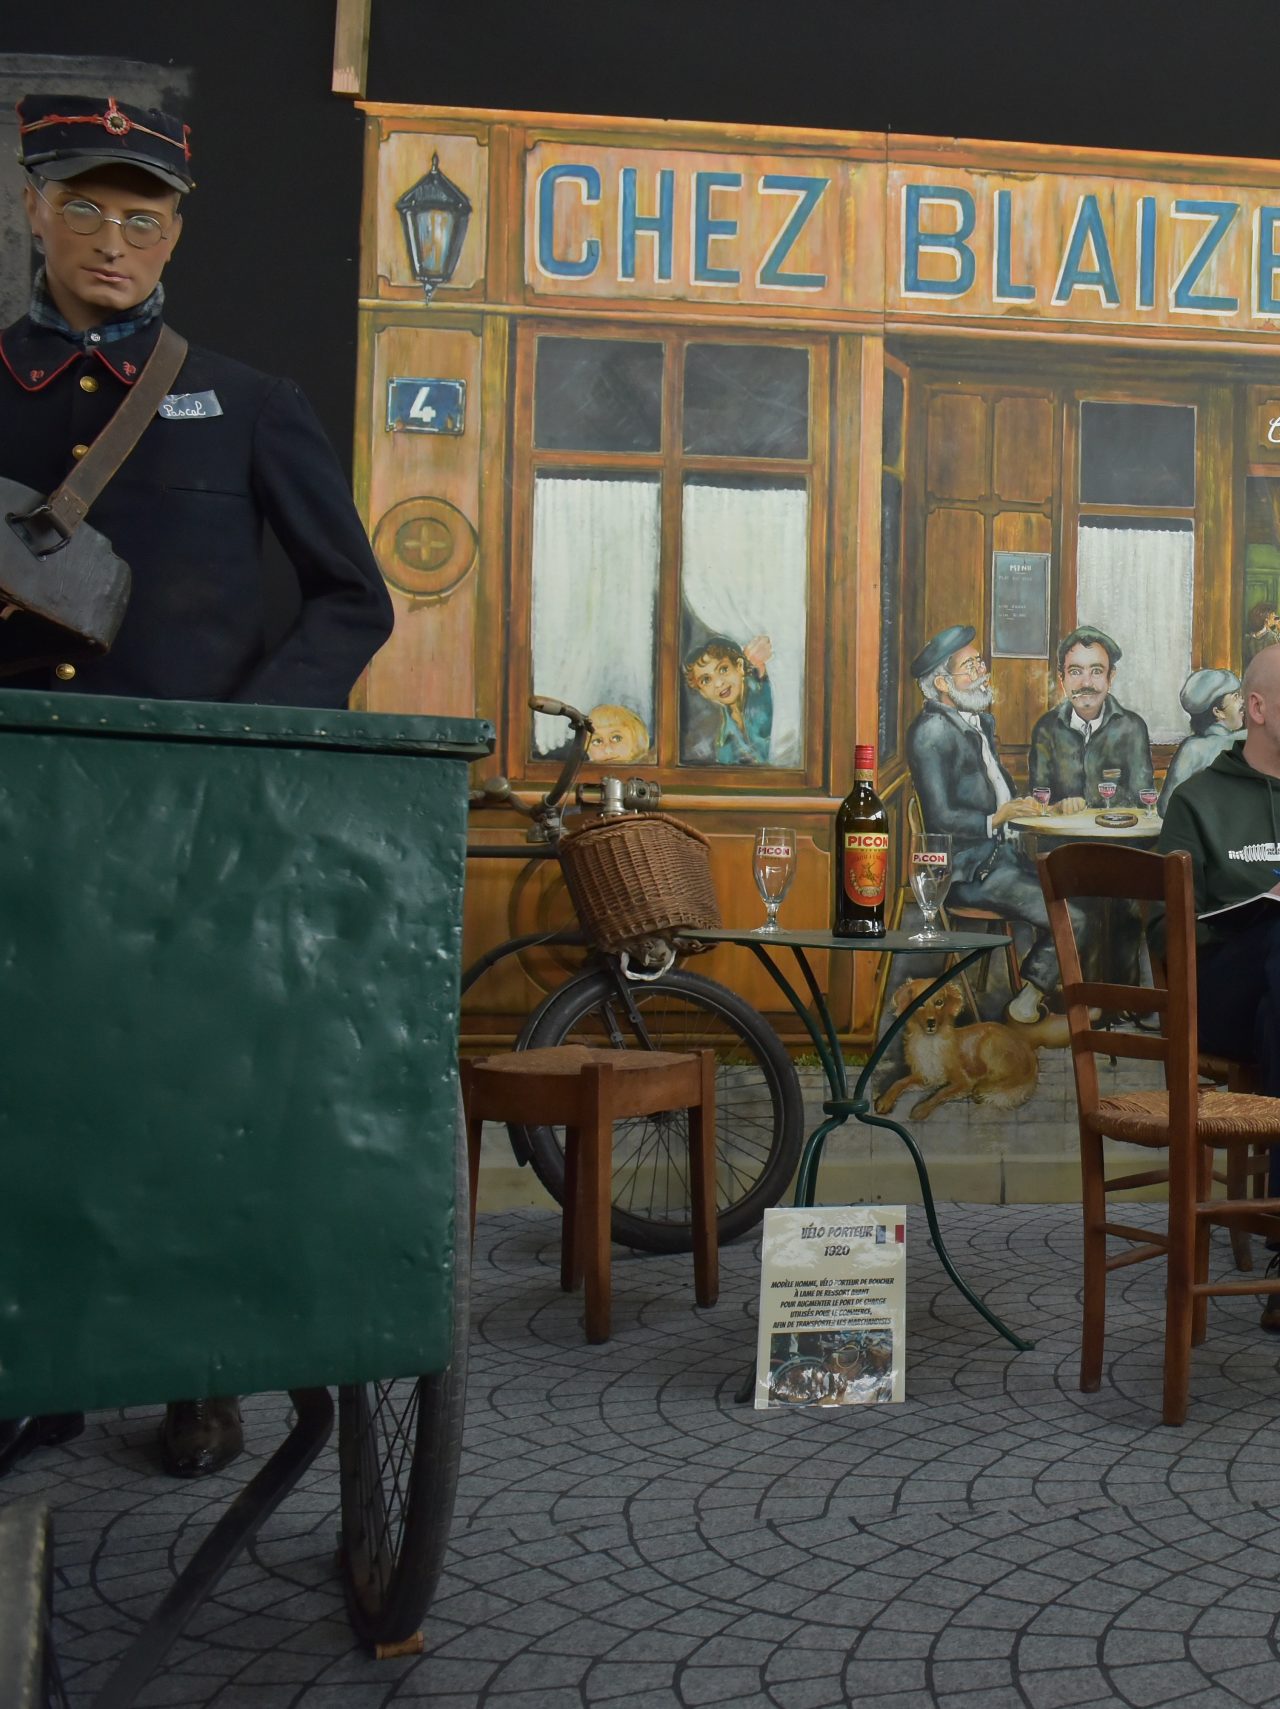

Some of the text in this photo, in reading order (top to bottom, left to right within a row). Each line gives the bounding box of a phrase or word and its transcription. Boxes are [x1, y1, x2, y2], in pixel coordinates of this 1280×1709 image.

[535, 163, 831, 292] CHEZ
[163, 400, 206, 417] Pascal
[409, 386, 436, 423] 4
[847, 835, 888, 847] PICON
[757, 846, 790, 856] PICON
[913, 854, 945, 863] PICON
[801, 1222, 874, 1239] VÉLO PORTEUR
[824, 1245, 851, 1257] 1920
[771, 1279, 793, 1288] MODÈLE
[800, 1289, 815, 1297] LAME
[815, 1289, 823, 1297] DE
[780, 1300, 796, 1308] POUR
[796, 1299, 831, 1308] AUGMENTER
[832, 1299, 839, 1307] LE
[839, 1298, 855, 1306] PORT
[787, 1320, 795, 1328] DE
